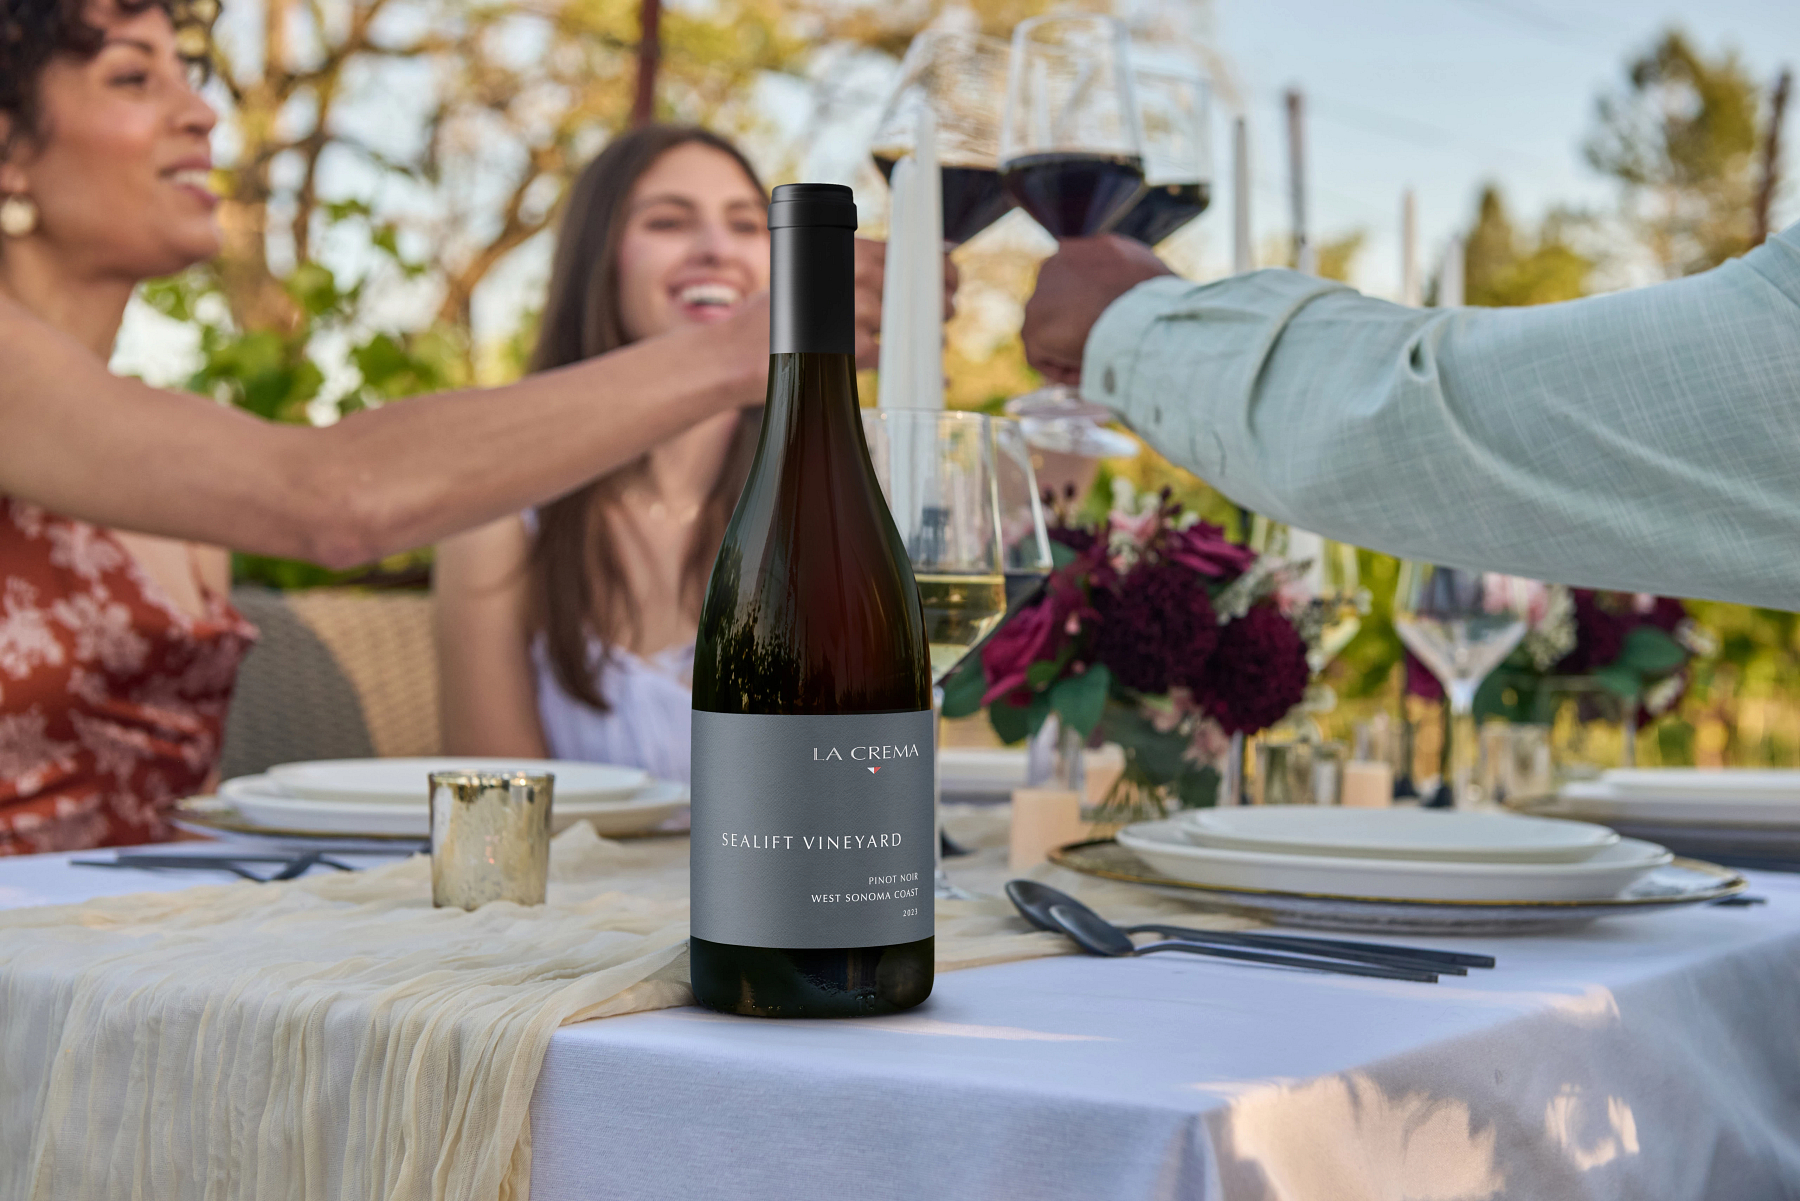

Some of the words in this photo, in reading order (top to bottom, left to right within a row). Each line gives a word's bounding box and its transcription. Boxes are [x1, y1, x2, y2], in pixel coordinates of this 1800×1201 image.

[813, 747, 843, 761] LA
[850, 743, 919, 761] CREMA
[721, 832, 794, 850] SEALIFT
[802, 832, 902, 850] VINEYARD
[868, 874, 898, 885] PINOT
[900, 872, 919, 883] NOIR
[811, 894, 842, 903] WEST
[845, 891, 892, 902] SONOMA
[893, 887, 919, 899] COAST
[902, 908, 918, 917] 2023
